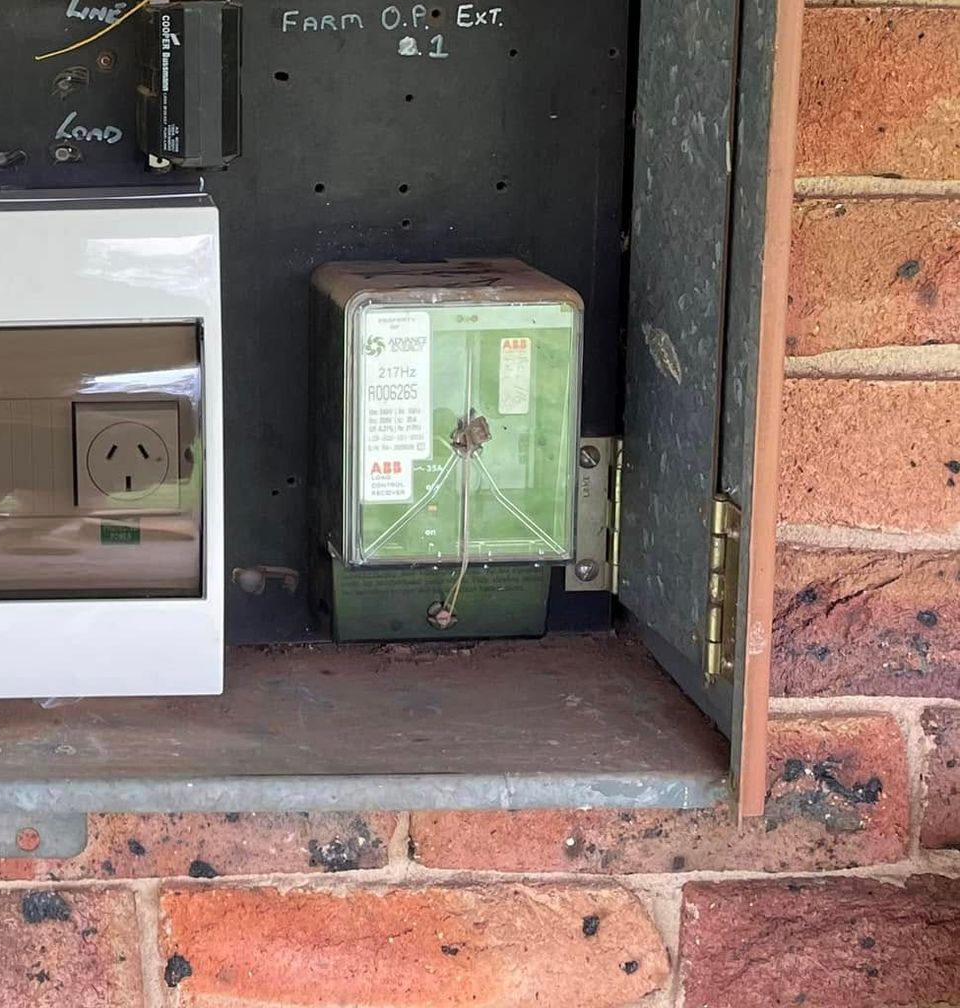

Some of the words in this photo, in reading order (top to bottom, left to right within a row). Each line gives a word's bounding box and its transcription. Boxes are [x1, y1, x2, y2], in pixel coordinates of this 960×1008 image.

[282, 9, 364, 32] FARM
[162, 15, 170, 50] COOPER
[162, 52, 170, 92] Bussmann
[503, 340, 527, 349] ABB
[378, 365, 417, 379] 217Hz
[371, 460, 402, 475] ABB
